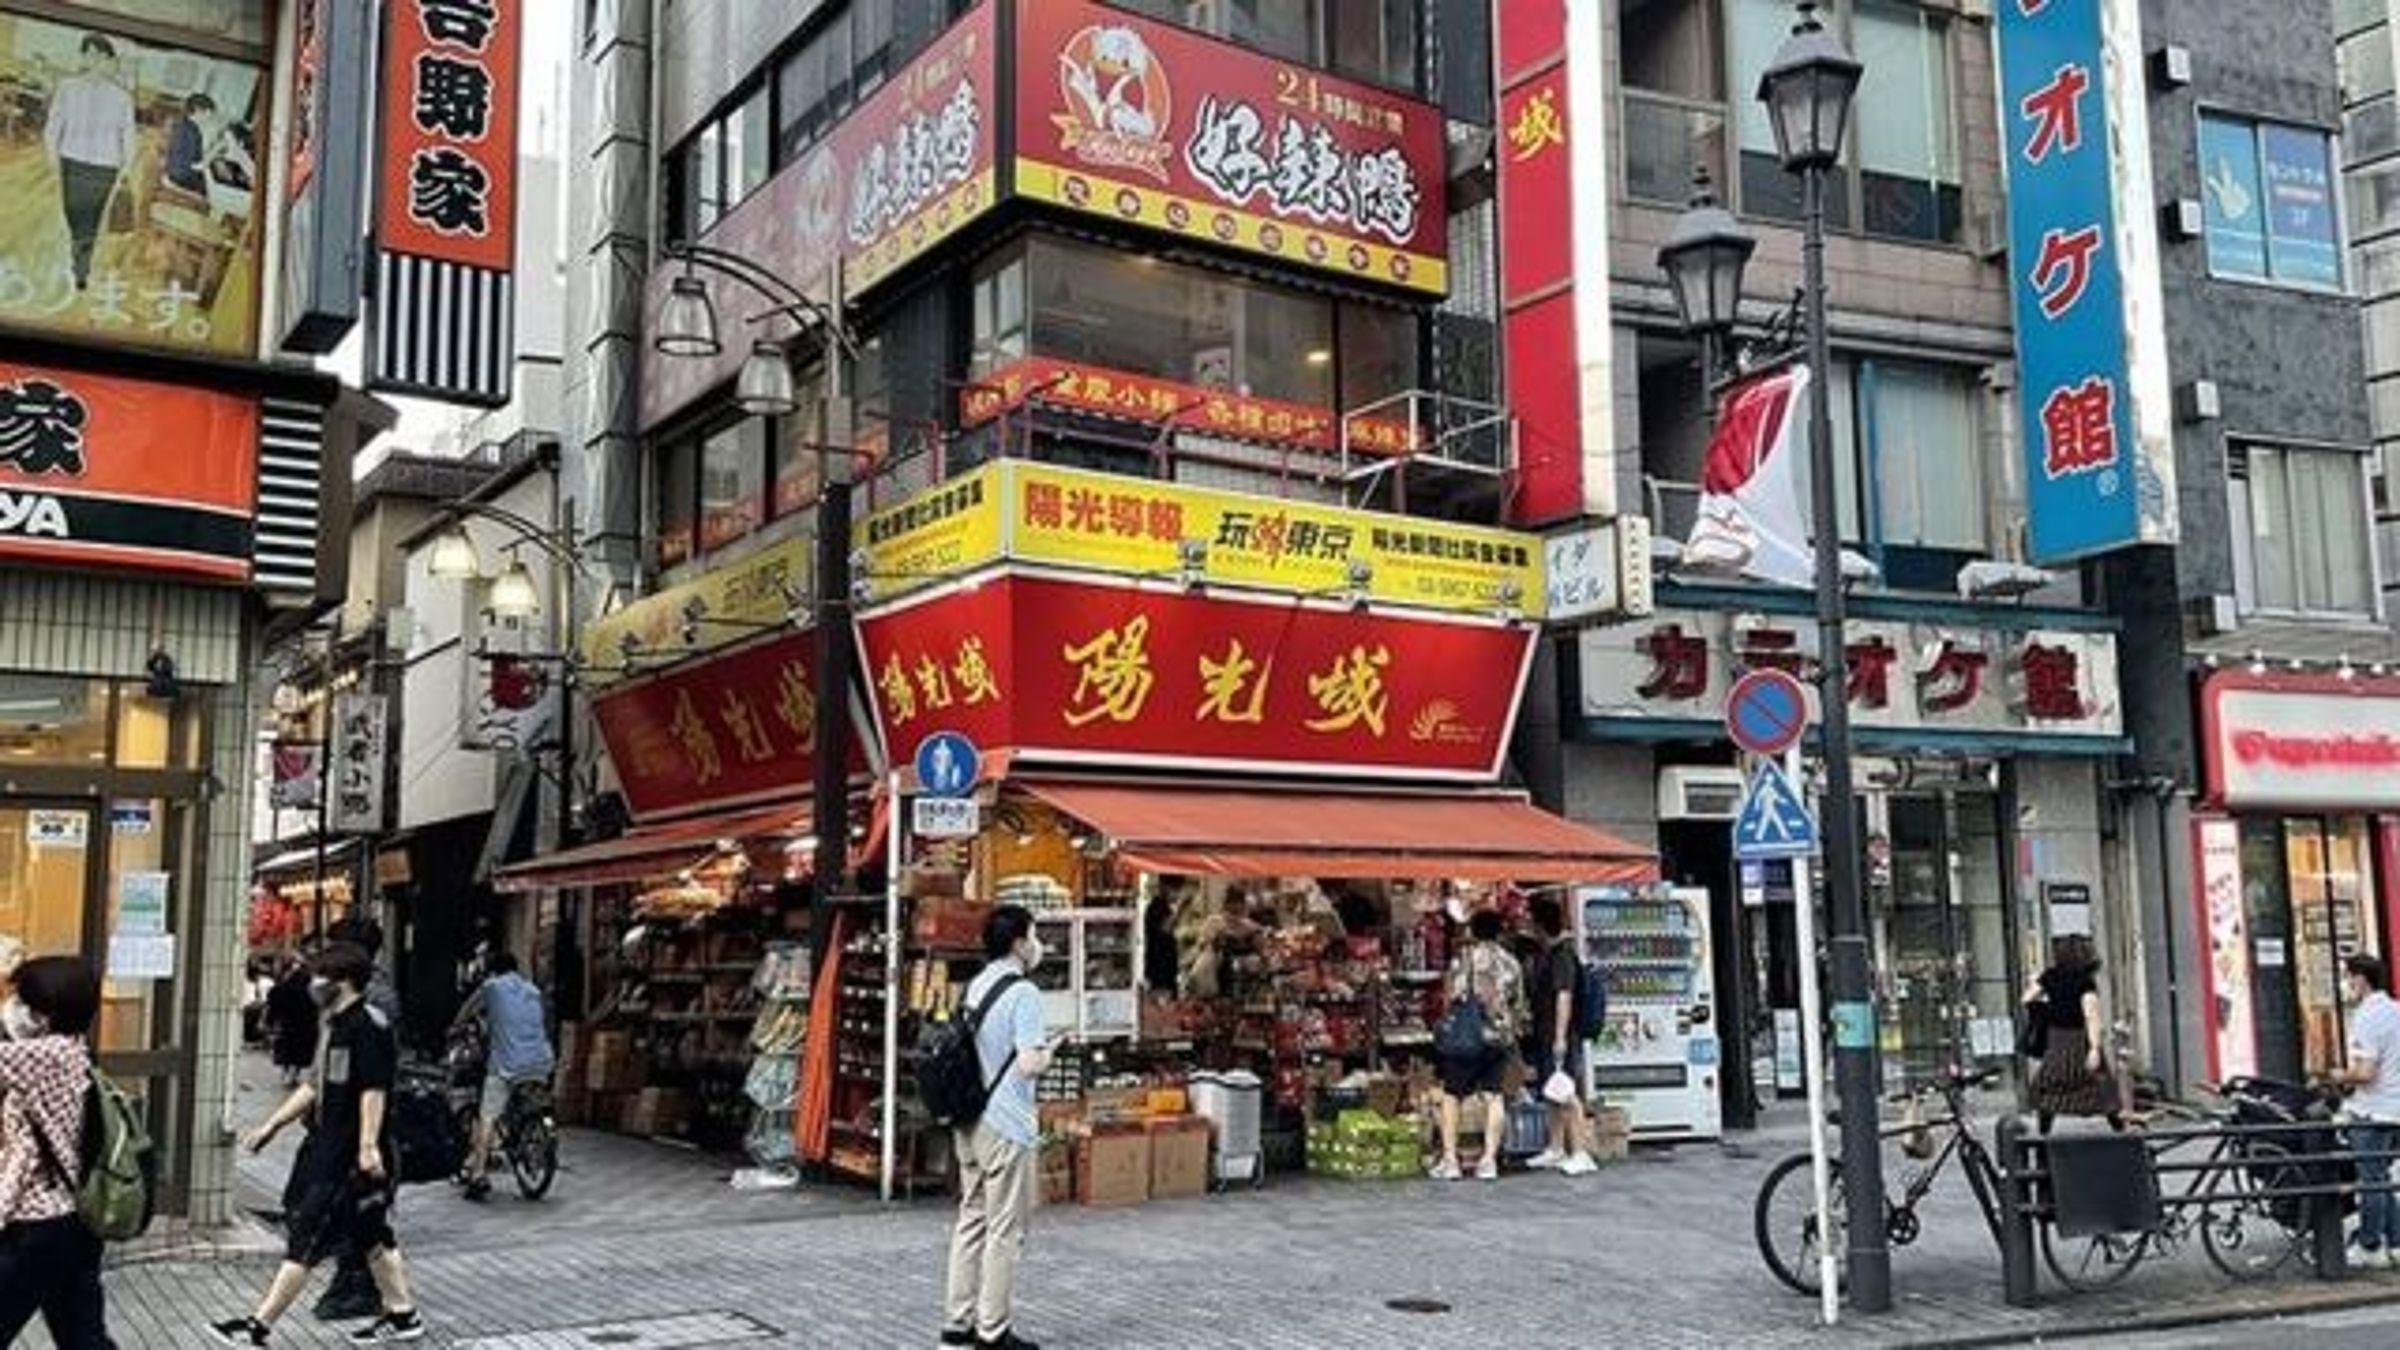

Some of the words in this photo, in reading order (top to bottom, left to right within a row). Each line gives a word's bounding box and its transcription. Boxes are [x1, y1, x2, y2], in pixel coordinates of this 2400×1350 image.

[2013, 0, 2117, 481] オケ館
[0, 382, 86, 475] 家
[1063, 614, 1391, 738] 陽光城
